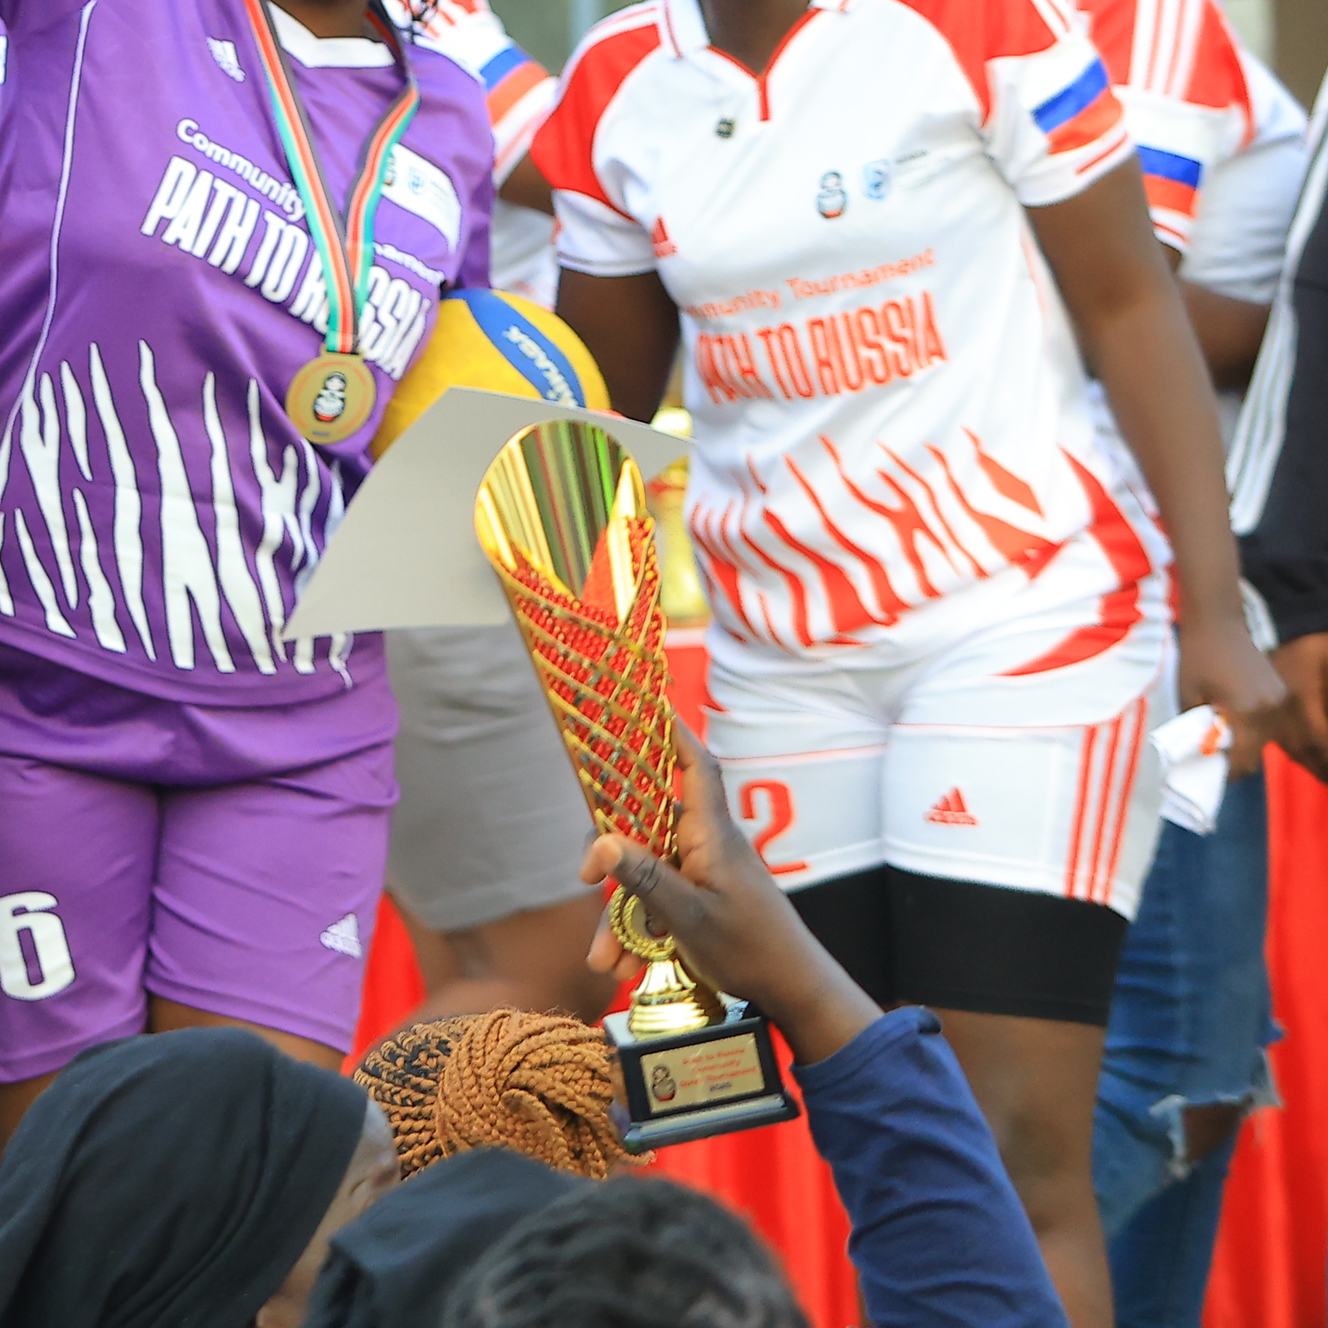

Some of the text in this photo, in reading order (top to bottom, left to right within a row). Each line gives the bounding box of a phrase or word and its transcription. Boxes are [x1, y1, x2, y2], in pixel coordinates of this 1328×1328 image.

[140, 155, 261, 276] PATH
[244, 209, 311, 303] TO
[807, 289, 948, 398] RUSSIA
[739, 779, 809, 876] 2
